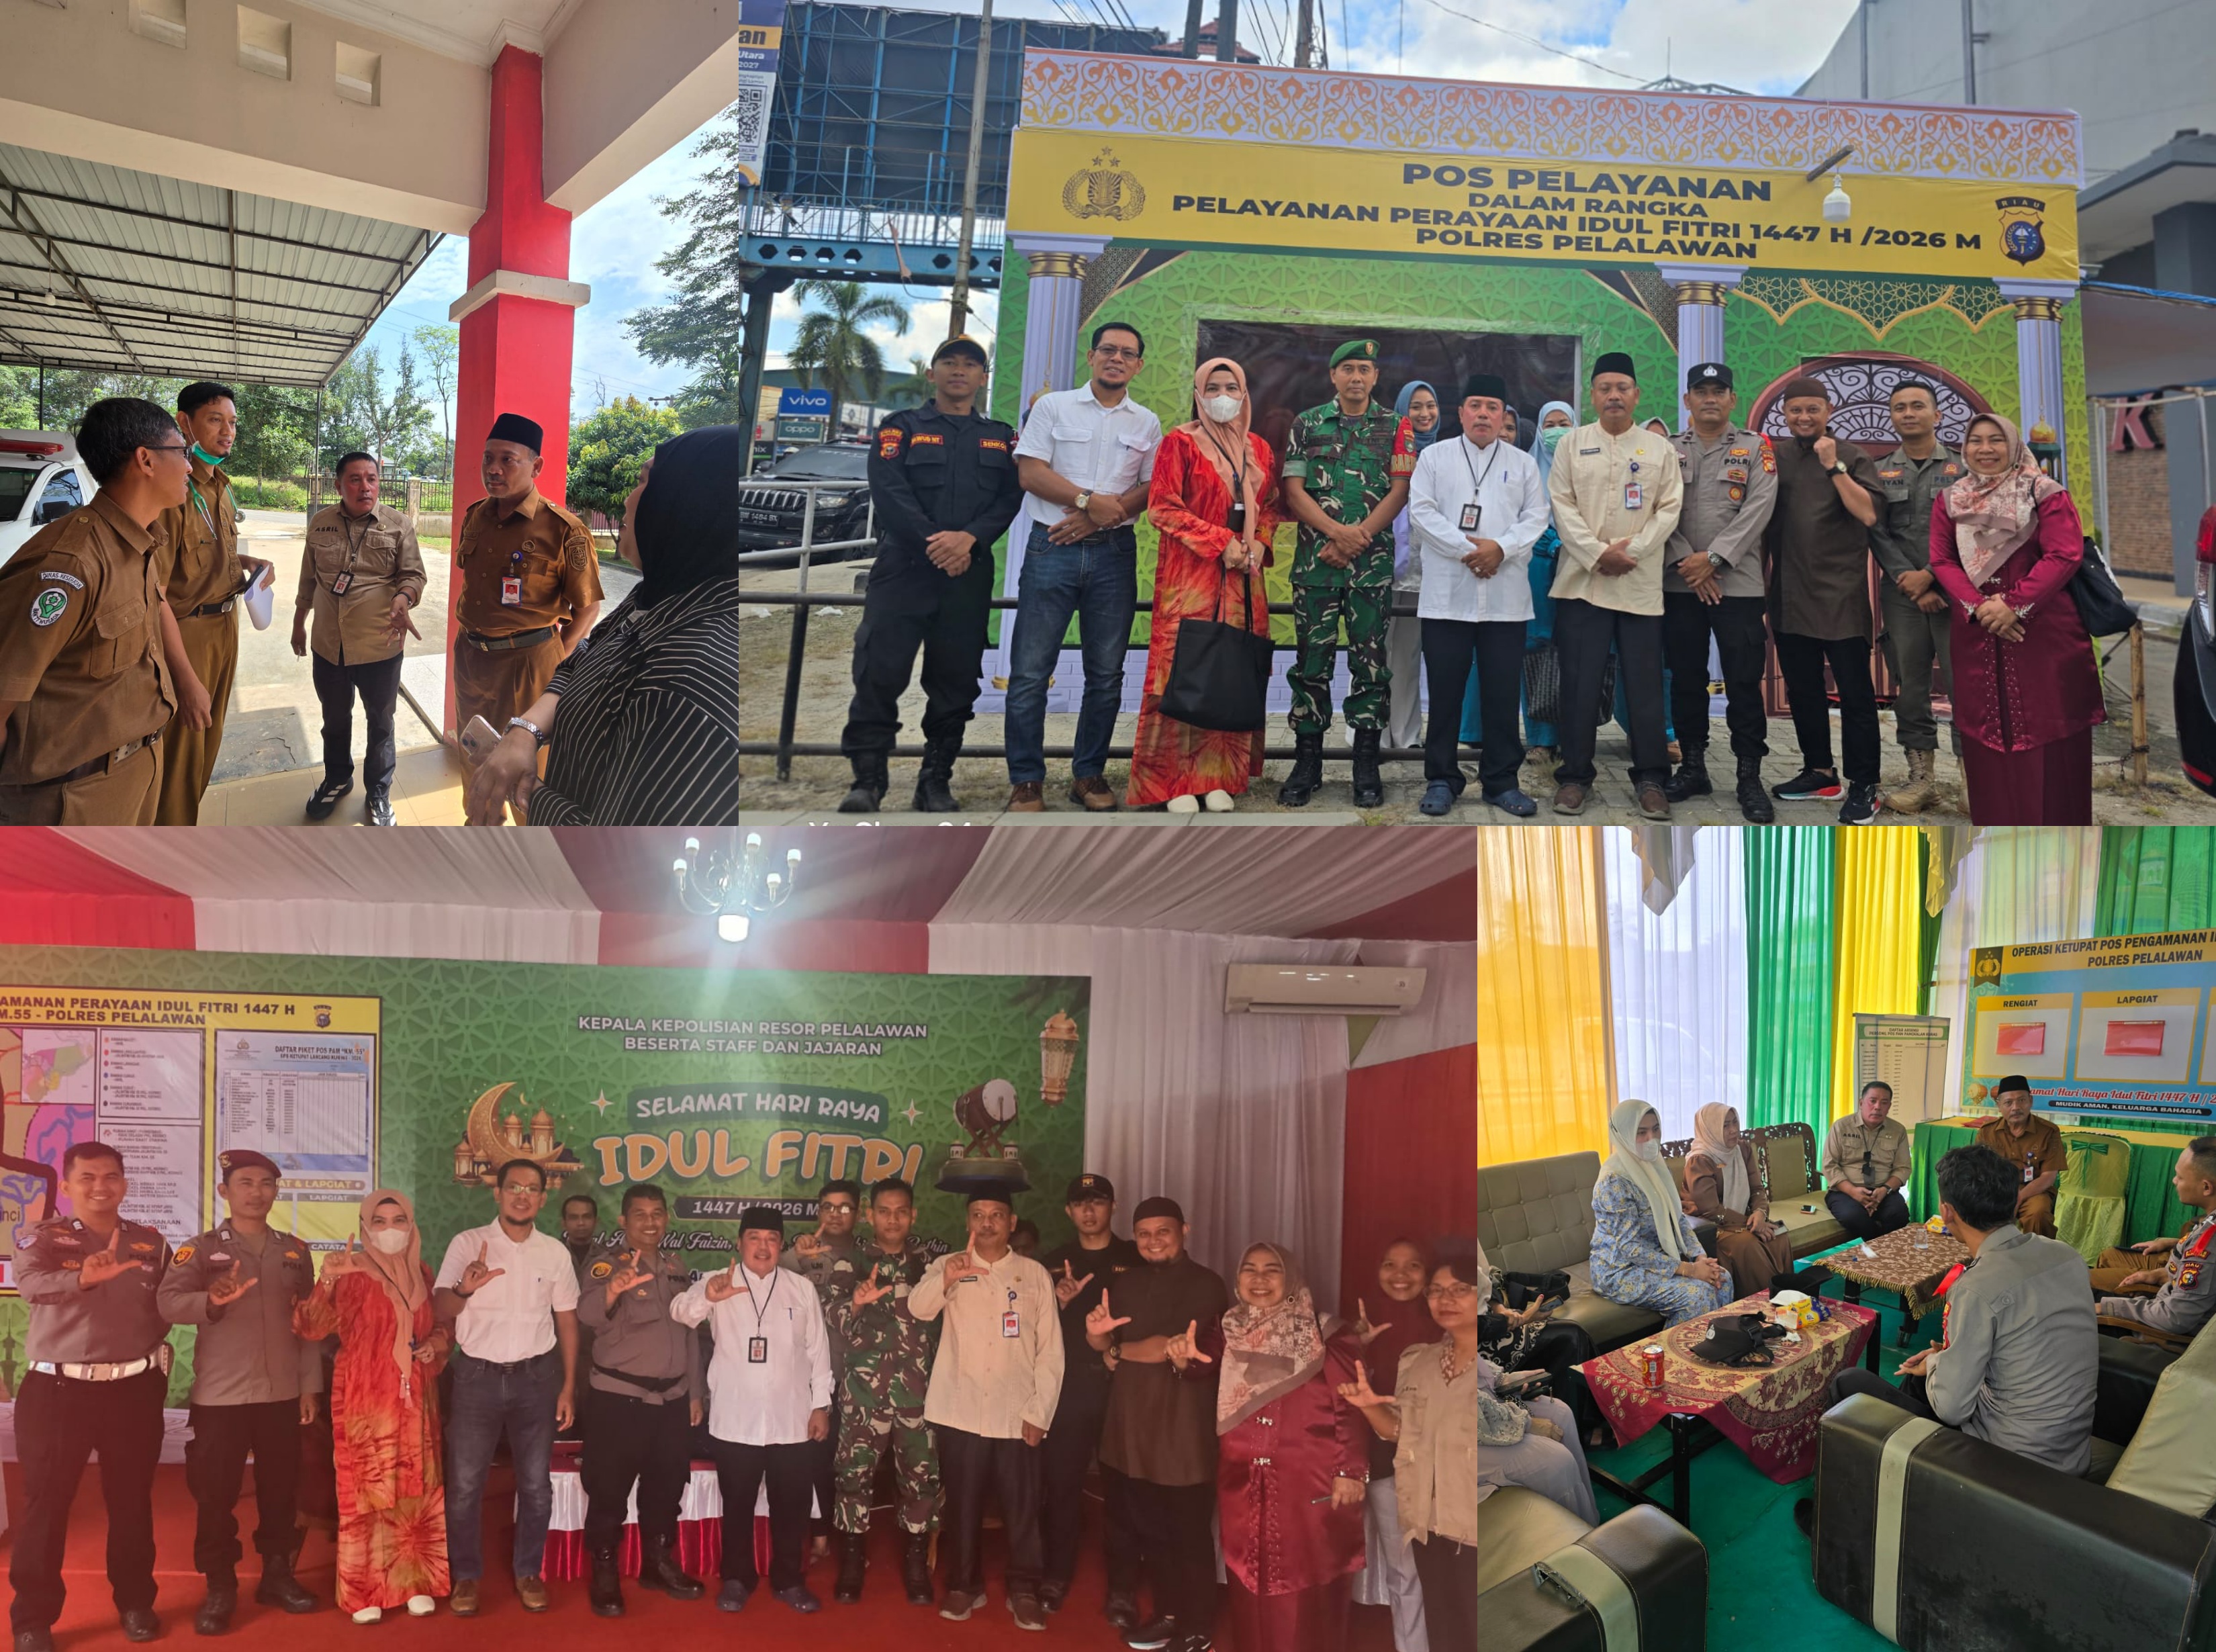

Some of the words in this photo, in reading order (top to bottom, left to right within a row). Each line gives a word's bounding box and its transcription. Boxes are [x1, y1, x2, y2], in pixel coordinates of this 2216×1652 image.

[1403, 163, 1494, 189] POS
[1508, 168, 1771, 201] PELAYANAN
[1469, 192, 1575, 212] DALAM
[1585, 198, 1709, 218] RANGKA
[2001, 199, 2040, 208] RIAU
[1172, 195, 1379, 222] PELAYANAN
[1390, 207, 1567, 231] PERAYAAN
[1578, 217, 1653, 235] IDUL
[1663, 220, 1741, 239] FITRI
[1750, 223, 1821, 242] 1447
[1830, 227, 1852, 244] H
[1860, 226, 1947, 249] /2026
[1955, 233, 1981, 250] M
[1416, 228, 1543, 250] POLRES
[1553, 235, 1757, 260] PELALAWAN
[788, 395, 827, 406] vivo
[785, 425, 815, 433] oppo
[2012, 945, 2053, 958] OPERASI
[2055, 940, 2098, 954] KETUPAT
[2100, 939, 2122, 950] POS
[2124, 931, 2208, 949] PENGAMANAN
[2088, 954, 2129, 967] POLRES
[2131, 950, 2203, 964] PELALAWAN
[0, 997, 65, 1008] AMANAN
[71, 998, 152, 1011] PERAYAAN
[157, 1001, 193, 1012] IDUL
[199, 1001, 238, 1014] FITRI
[244, 1003, 279, 1015] 1447
[285, 1005, 295, 1015] H
[2003, 999, 2038, 1008] RENGIAT
[2117, 995, 2158, 1004] LAPGIAT
[46, 1010, 105, 1021] POLRES
[111, 1012, 205, 1025] PELALAWAN
[578, 1016, 647, 1032] KEPALA
[651, 1019, 754, 1035] KEPOLISIAN
[759, 1021, 816, 1036] RESOR
[820, 1023, 928, 1038] PELALAWAN
[625, 1036, 701, 1052] BESERTA
[706, 1039, 757, 1054] STAFF
[762, 1040, 799, 1054] DAN
[803, 1041, 882, 1056] JAJARAN
[2029, 1087, 2054, 1096] amat
[2056, 1087, 2079, 1097] Hari
[2081, 1088, 2108, 1100] Raya
[2110, 1090, 2133, 1099] Idul
[2135, 1091, 2158, 1101] Fitri
[2160, 1092, 2186, 1102] 1447
[2188, 1093, 2201, 1103] H
[636, 1092, 747, 1118] SELAMAT
[755, 1093, 810, 1113] HARI
[817, 1096, 880, 1123] RAYA
[2083, 1102, 2111, 1110] AMAN,
[2112, 1103, 2158, 1112] KELUARGA
[2160, 1106, 2203, 1115] BAHAGIA
[592, 1128, 750, 1187] IDUL
[764, 1130, 924, 1187] FITRI
[306, 1181, 352, 1189] LAPGIAT
[692, 1201, 735, 1214] 1447
